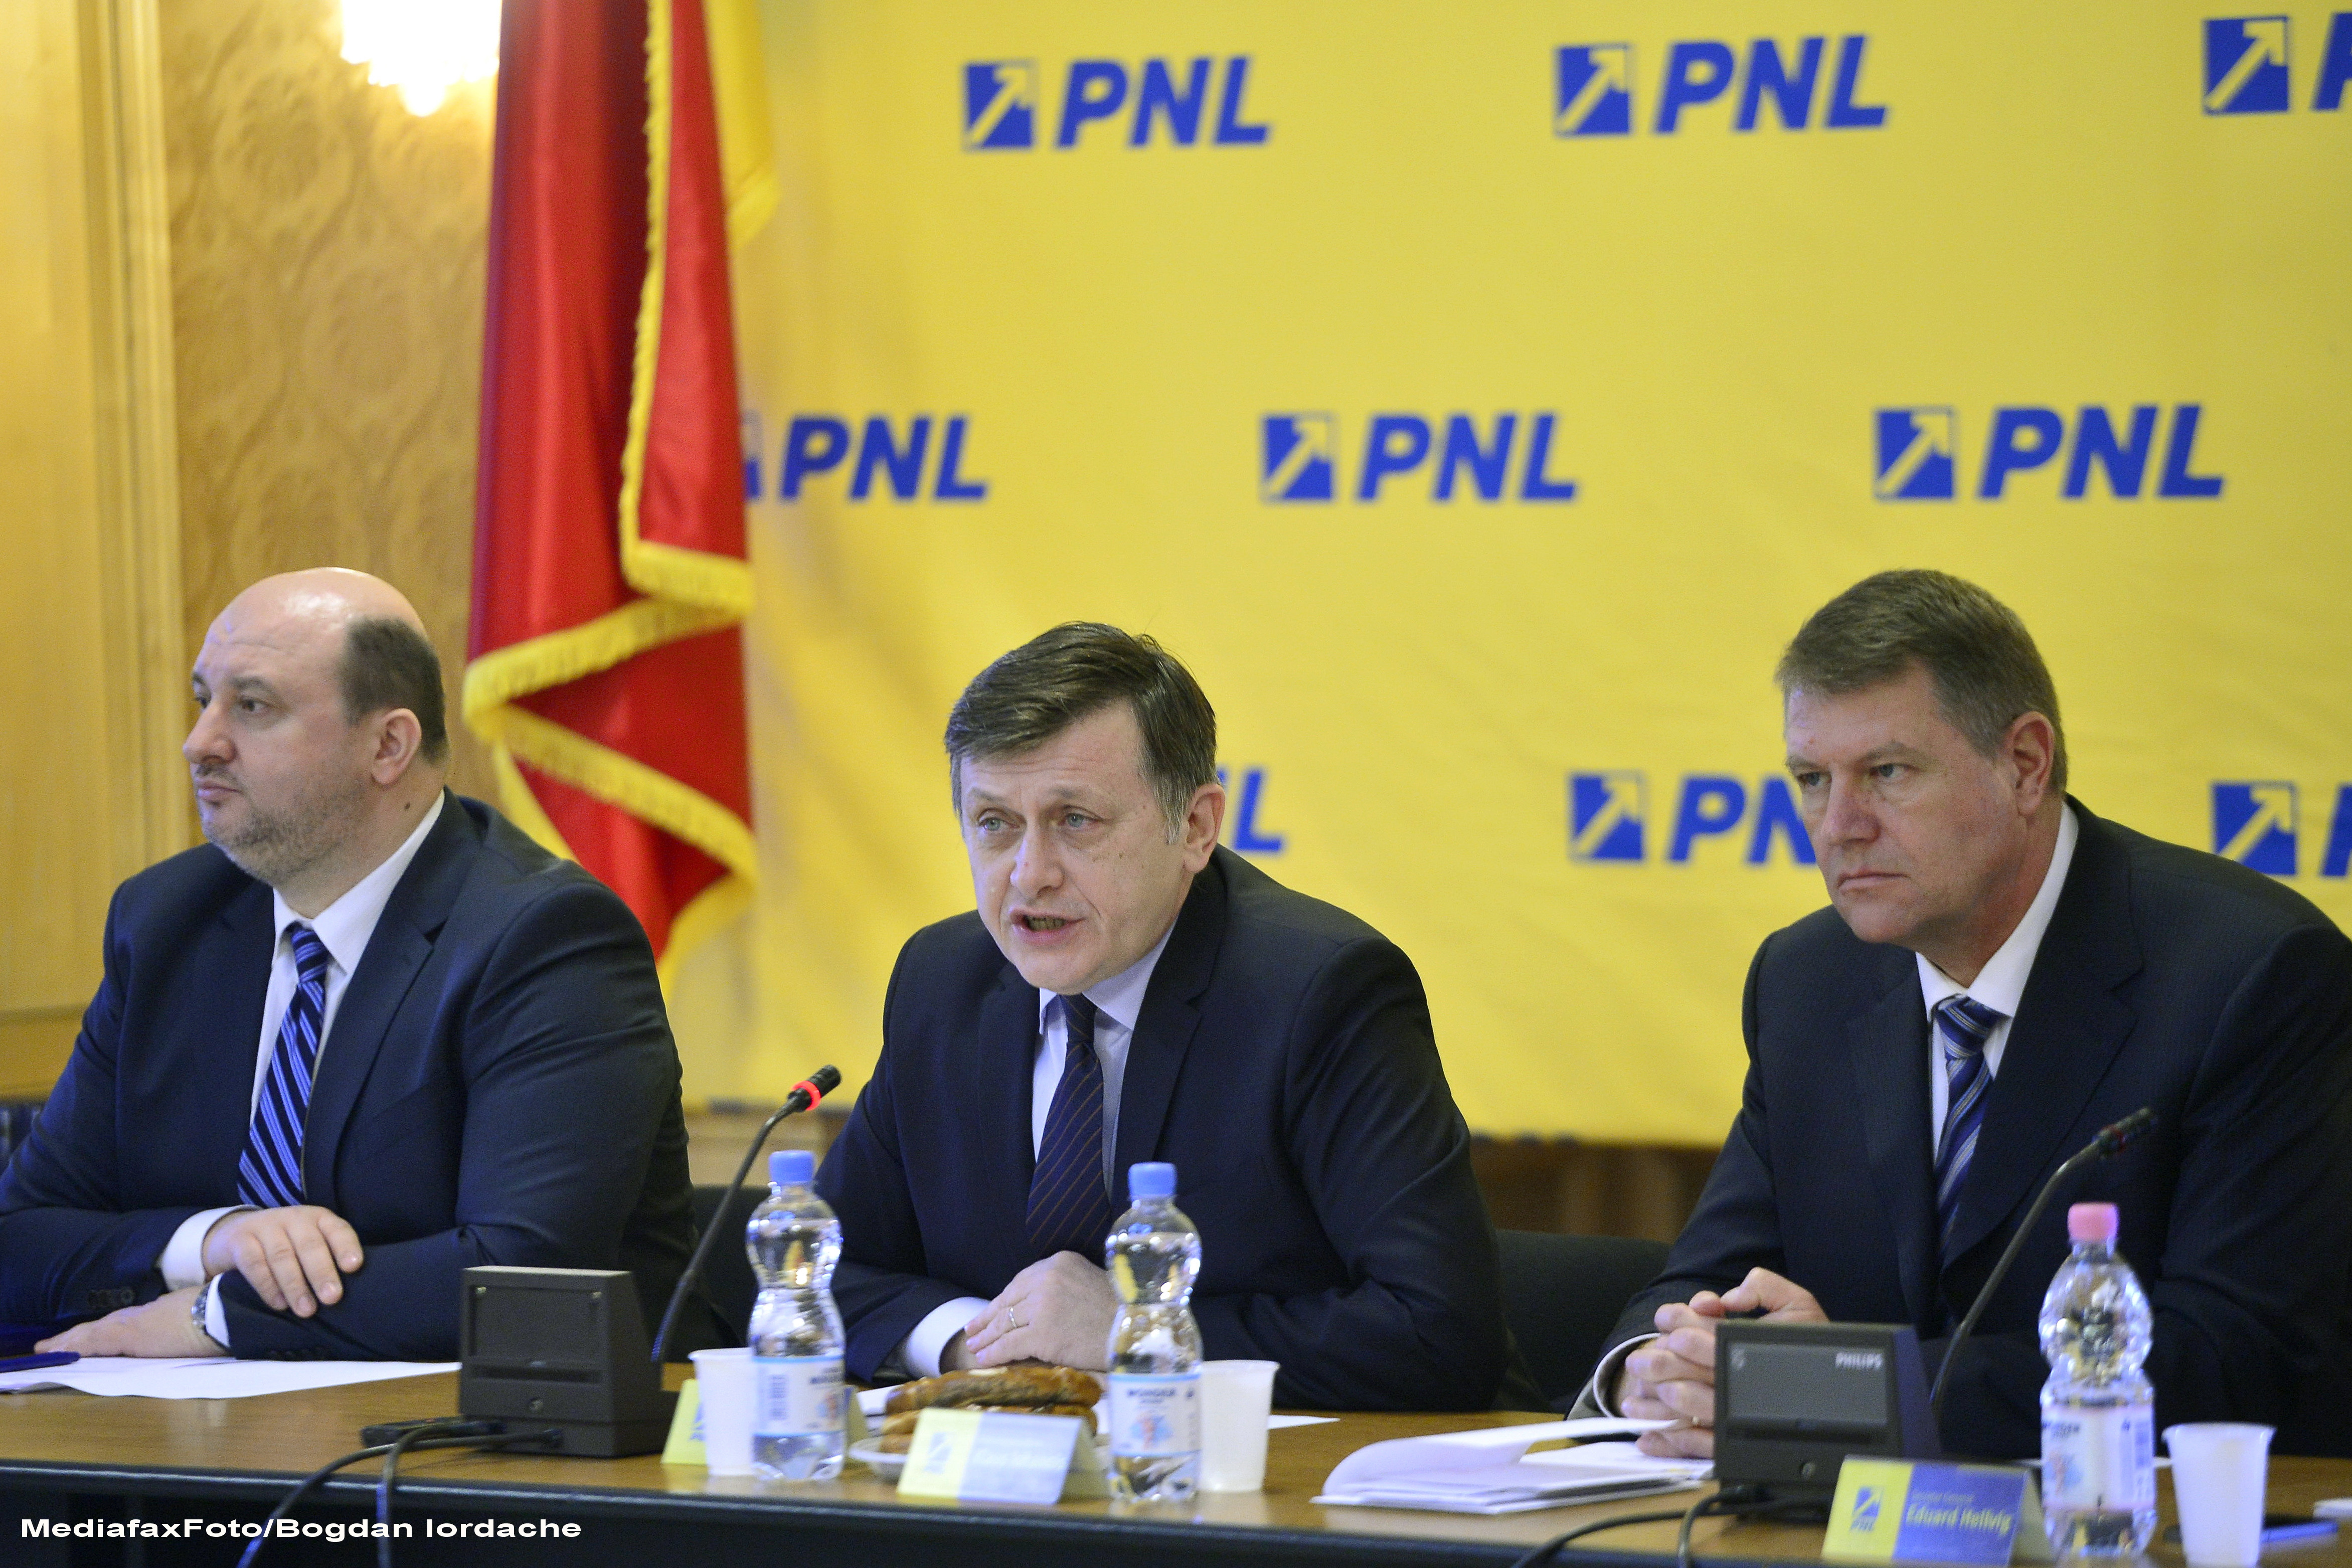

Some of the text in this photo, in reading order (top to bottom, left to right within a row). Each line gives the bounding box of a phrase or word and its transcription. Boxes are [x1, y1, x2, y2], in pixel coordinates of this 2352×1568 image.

[1056, 56, 1269, 148] PNL
[1655, 35, 1887, 134] PNL
[779, 417, 987, 501] PNL
[1357, 413, 1577, 502] PNL
[1978, 405, 2224, 499] PNL
[1667, 775, 1818, 865] PN
